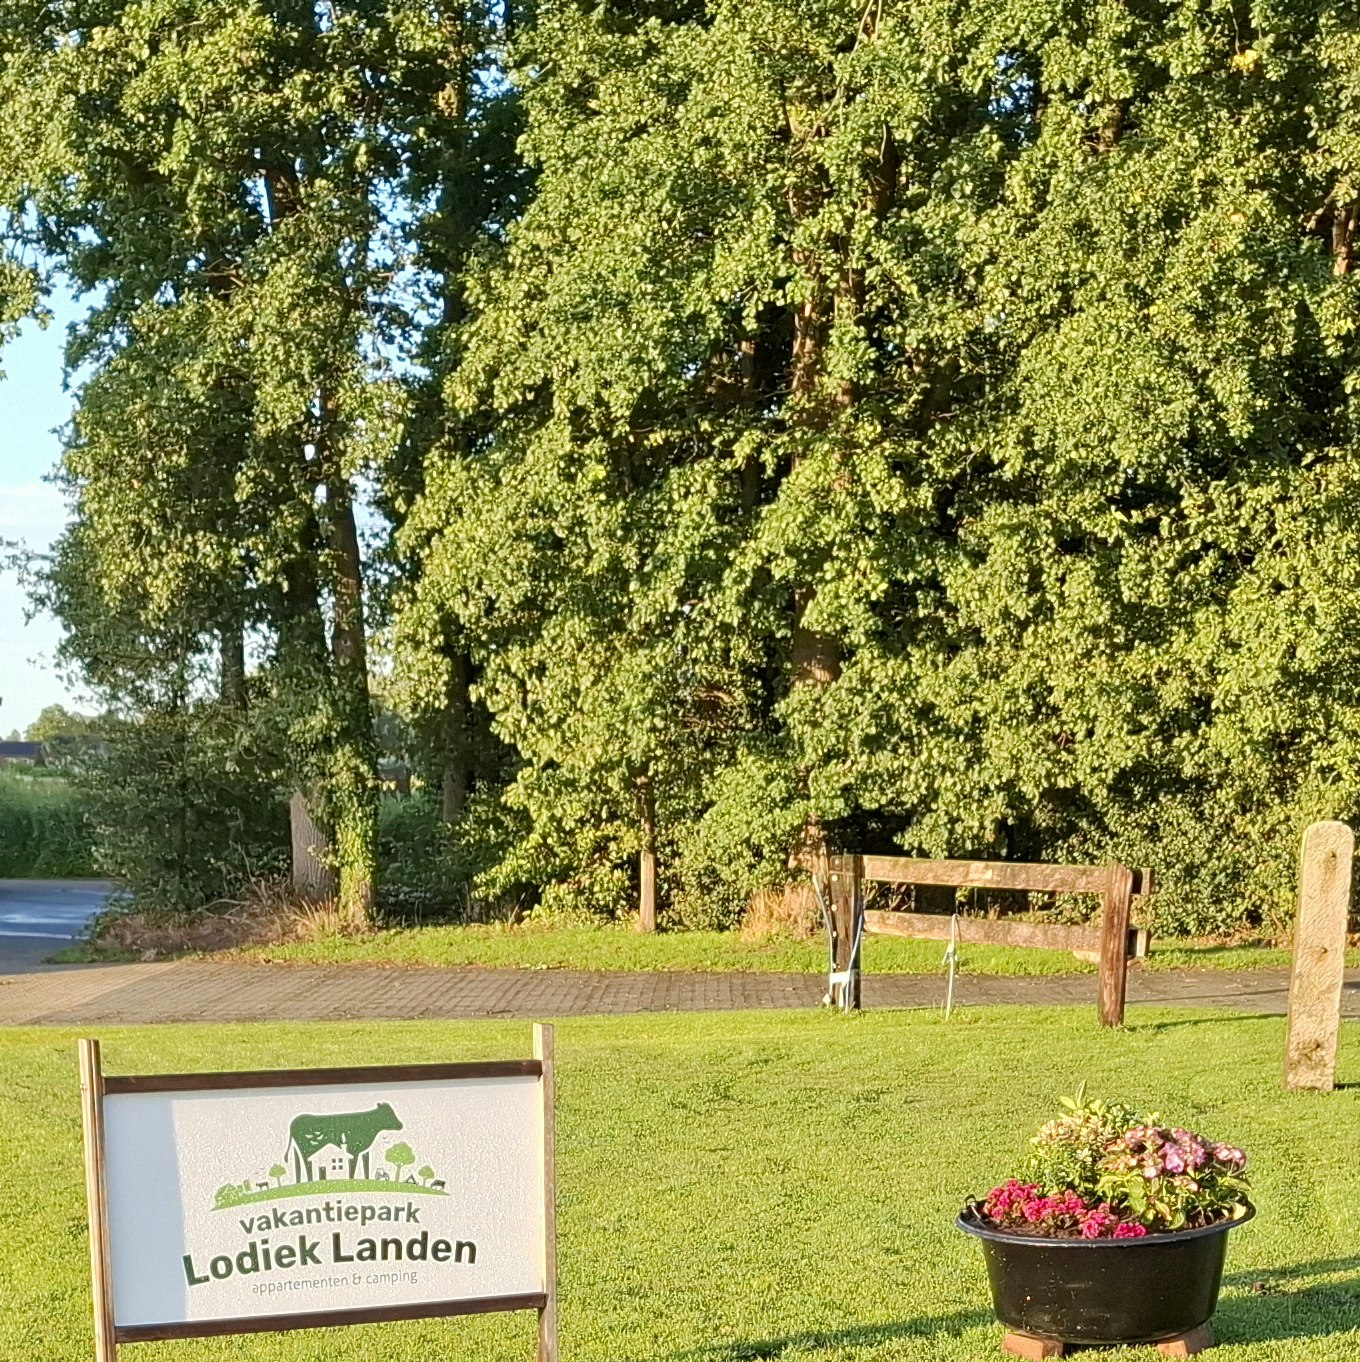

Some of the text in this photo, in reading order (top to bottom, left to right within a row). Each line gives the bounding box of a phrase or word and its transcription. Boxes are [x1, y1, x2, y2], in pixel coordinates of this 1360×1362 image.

[239, 1200, 421, 1235] vakantiepark
[183, 1230, 478, 1287] Lodiek Landen
[252, 1269, 419, 1295] appartementen & camping
